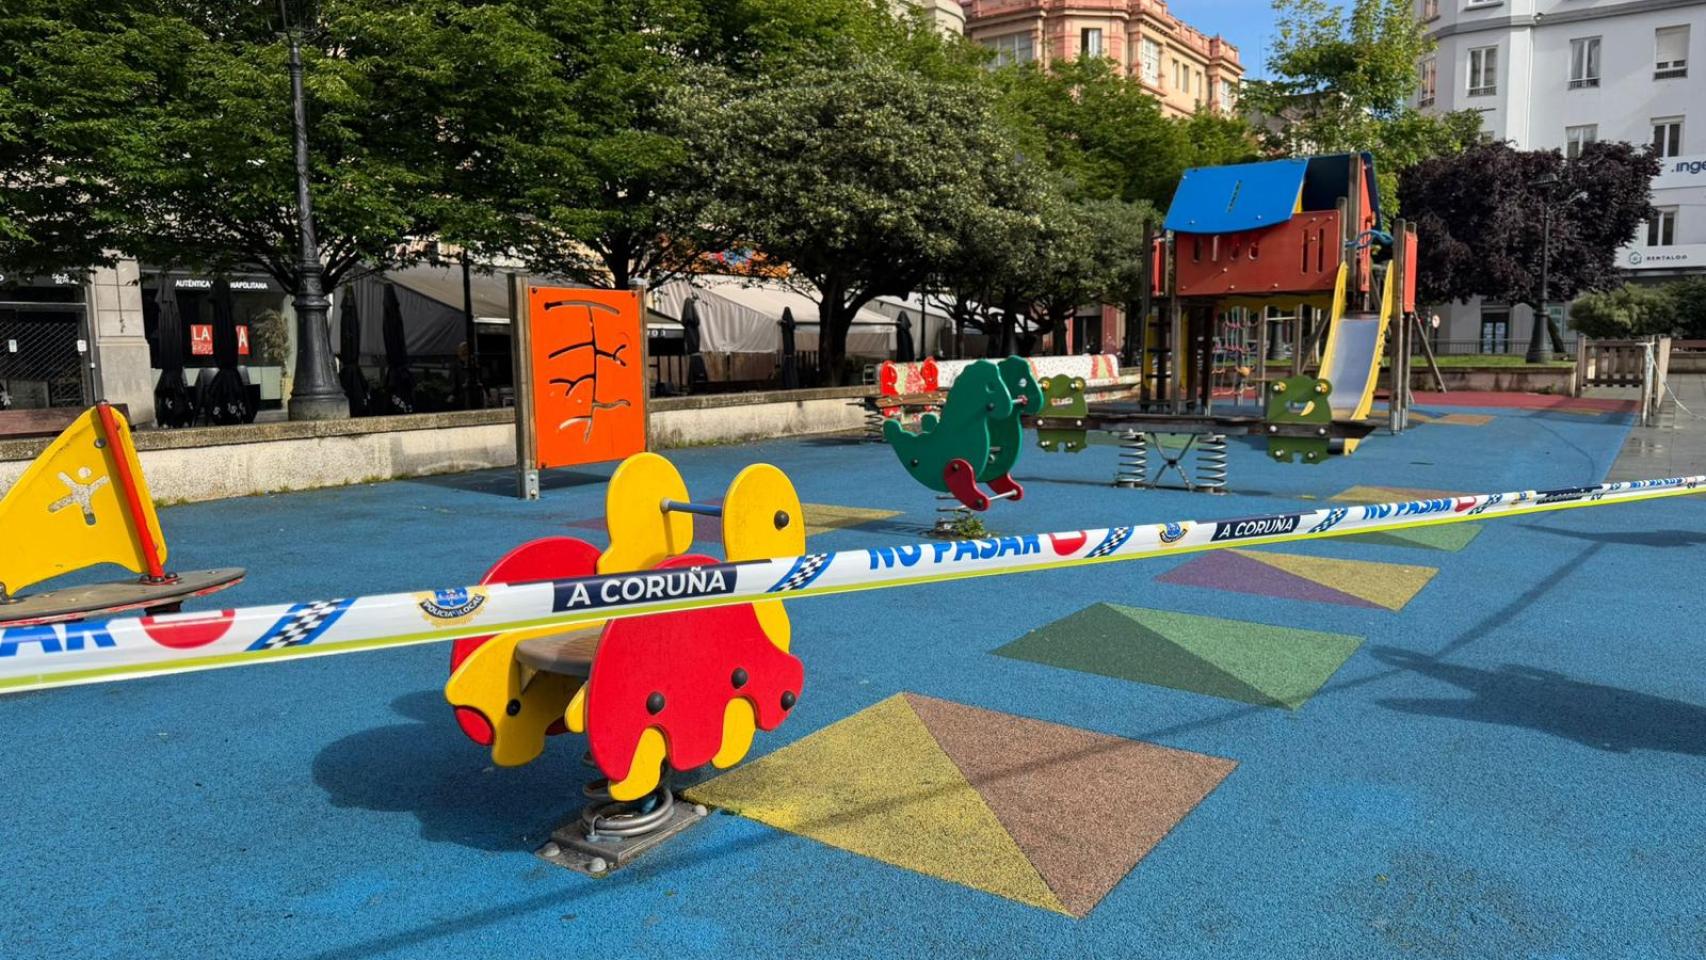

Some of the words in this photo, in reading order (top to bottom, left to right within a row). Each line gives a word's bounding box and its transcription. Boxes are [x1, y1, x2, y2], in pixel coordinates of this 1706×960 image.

[1218, 523, 1230, 539] A
[1234, 514, 1294, 537] CORUÑA
[566, 582, 592, 607] A
[600, 566, 727, 603] CORUÑA
